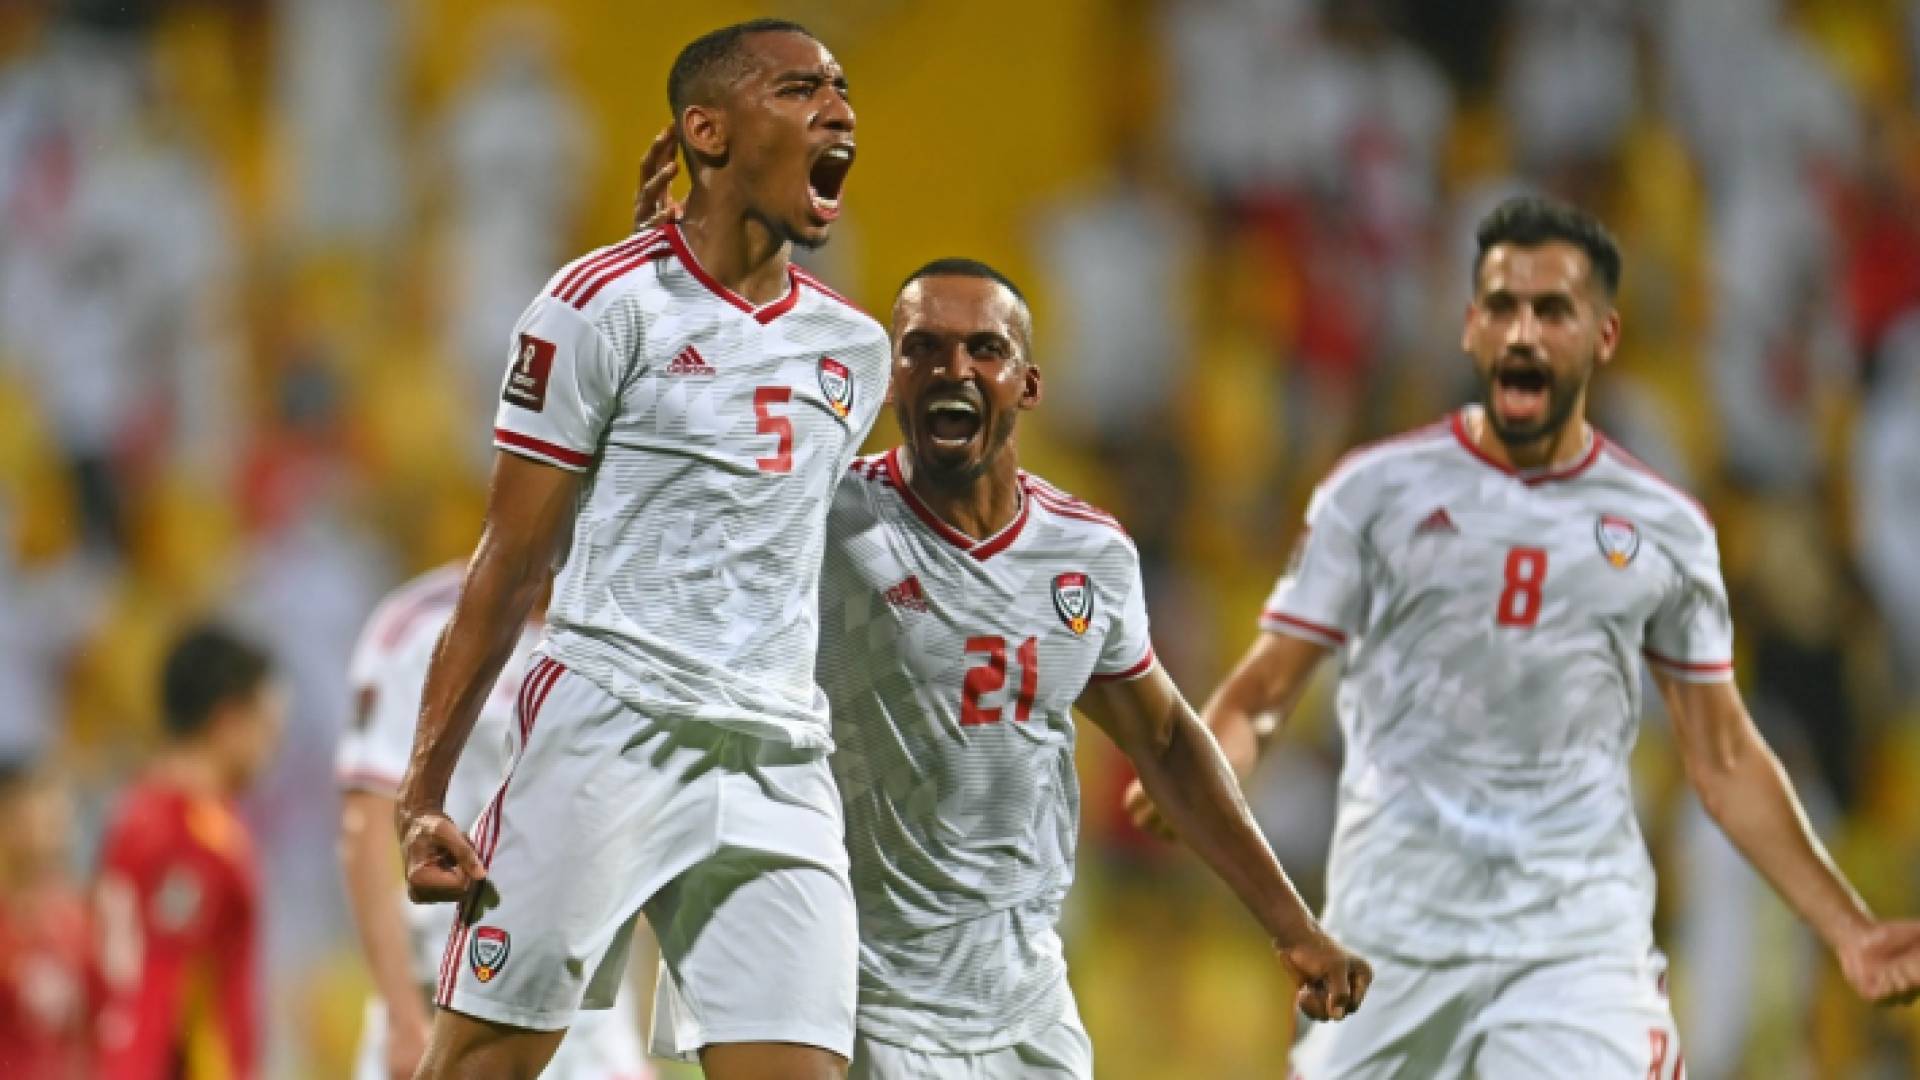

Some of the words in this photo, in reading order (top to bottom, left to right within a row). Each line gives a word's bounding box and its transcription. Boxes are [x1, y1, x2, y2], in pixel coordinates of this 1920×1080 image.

[754, 386, 792, 474] 5
[1497, 547, 1548, 627] 8
[959, 634, 1038, 726] 21
